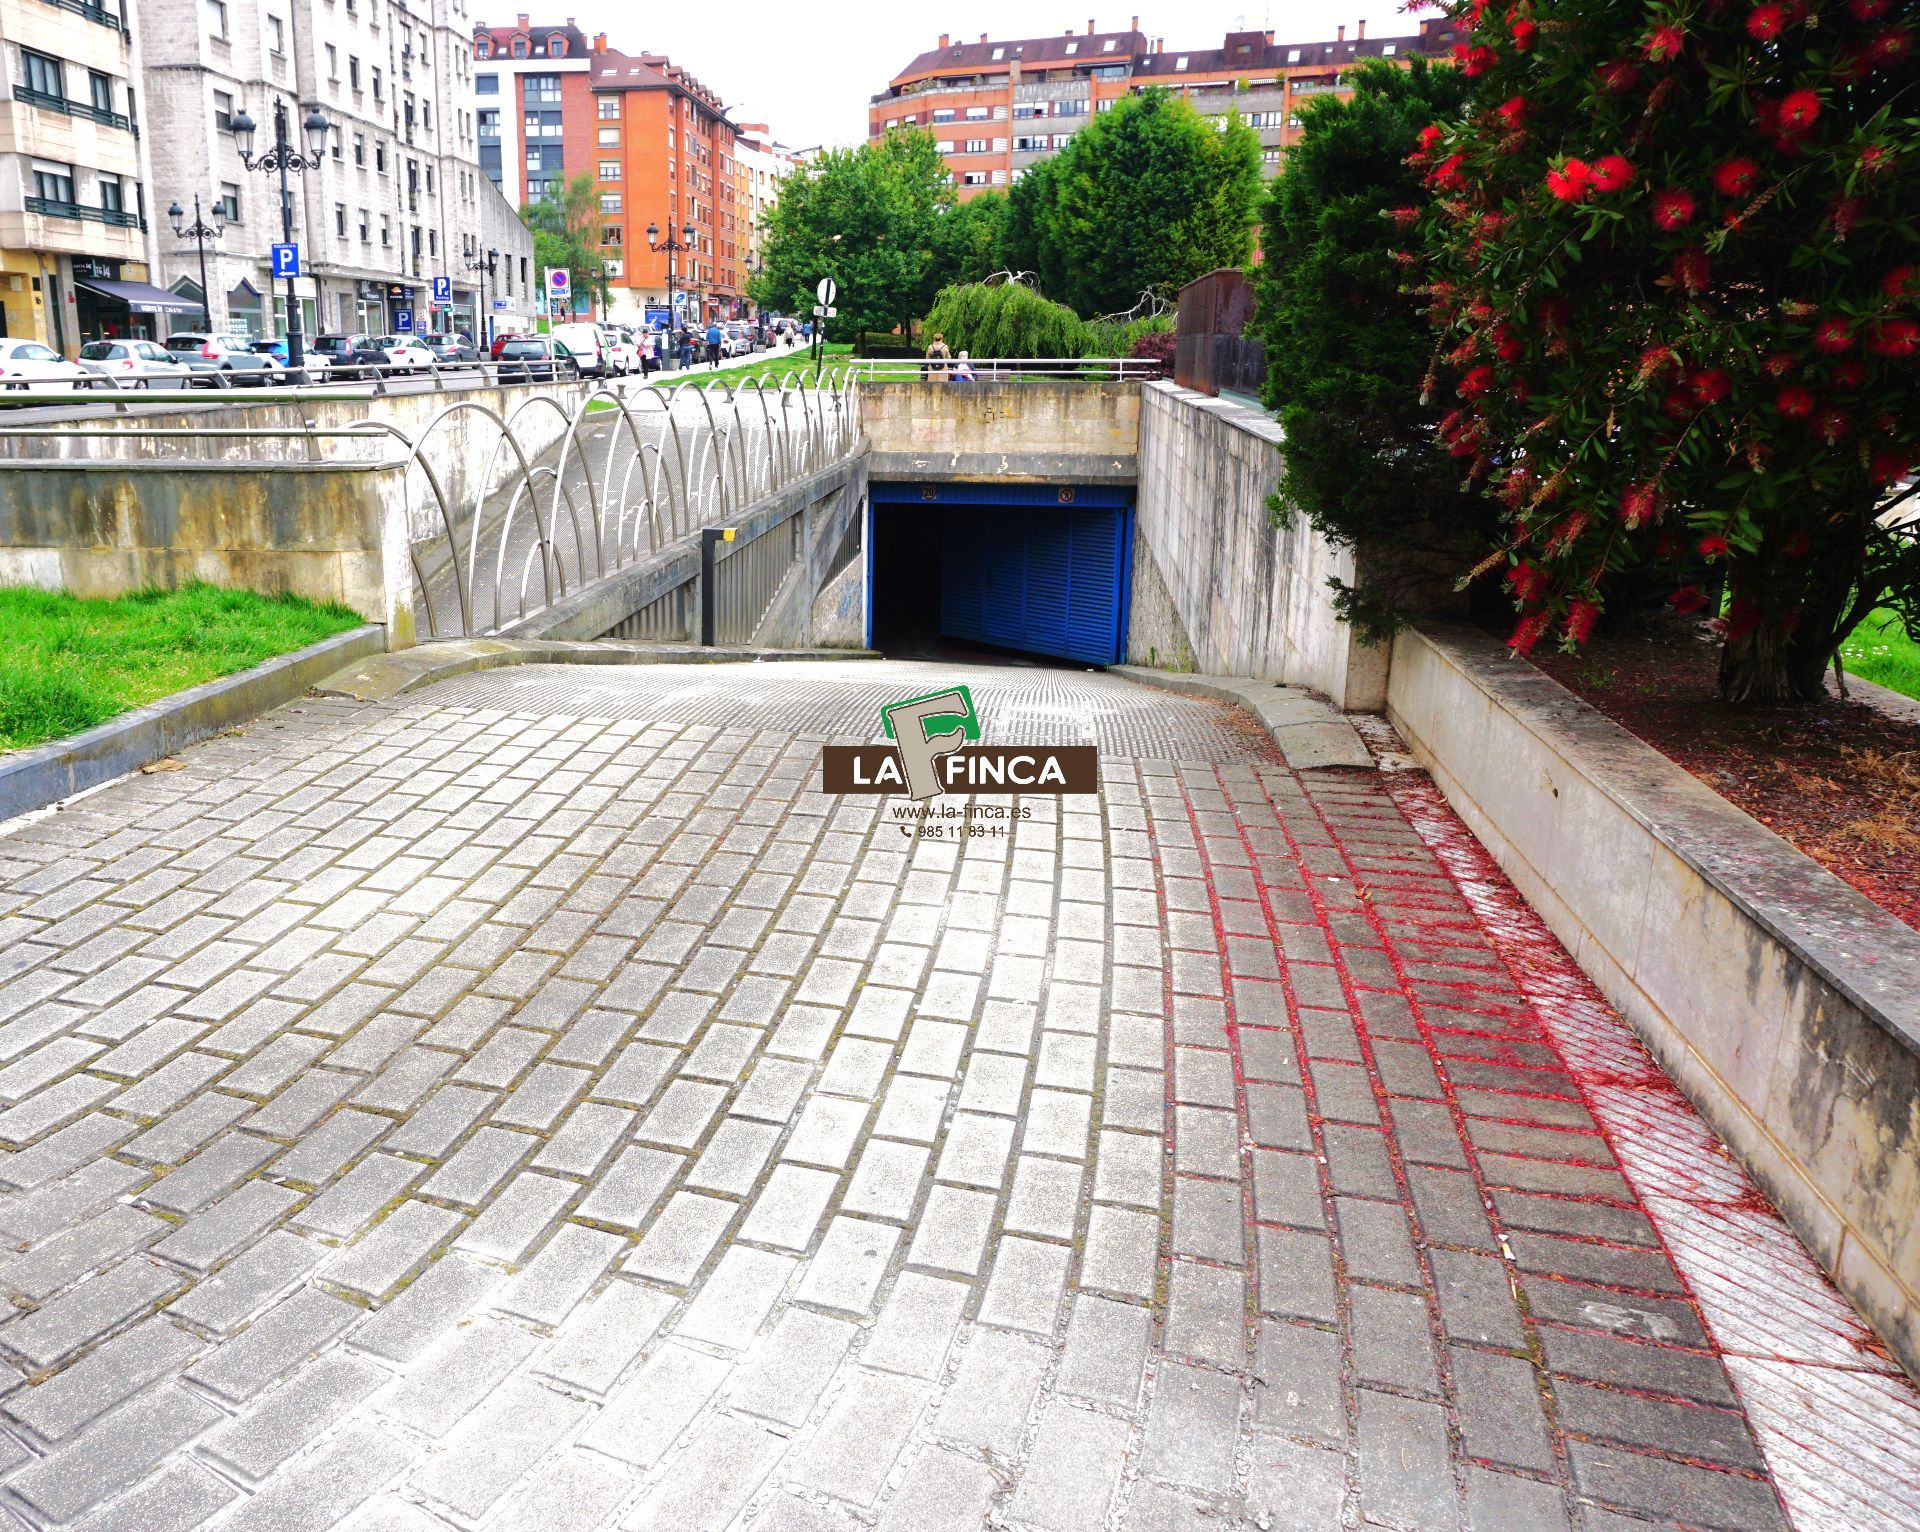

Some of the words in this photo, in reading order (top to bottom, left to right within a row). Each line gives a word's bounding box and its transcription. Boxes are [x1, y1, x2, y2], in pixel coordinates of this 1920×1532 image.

[280, 249, 293, 270] P
[437, 278, 447, 296] P
[398, 312, 409, 327] P
